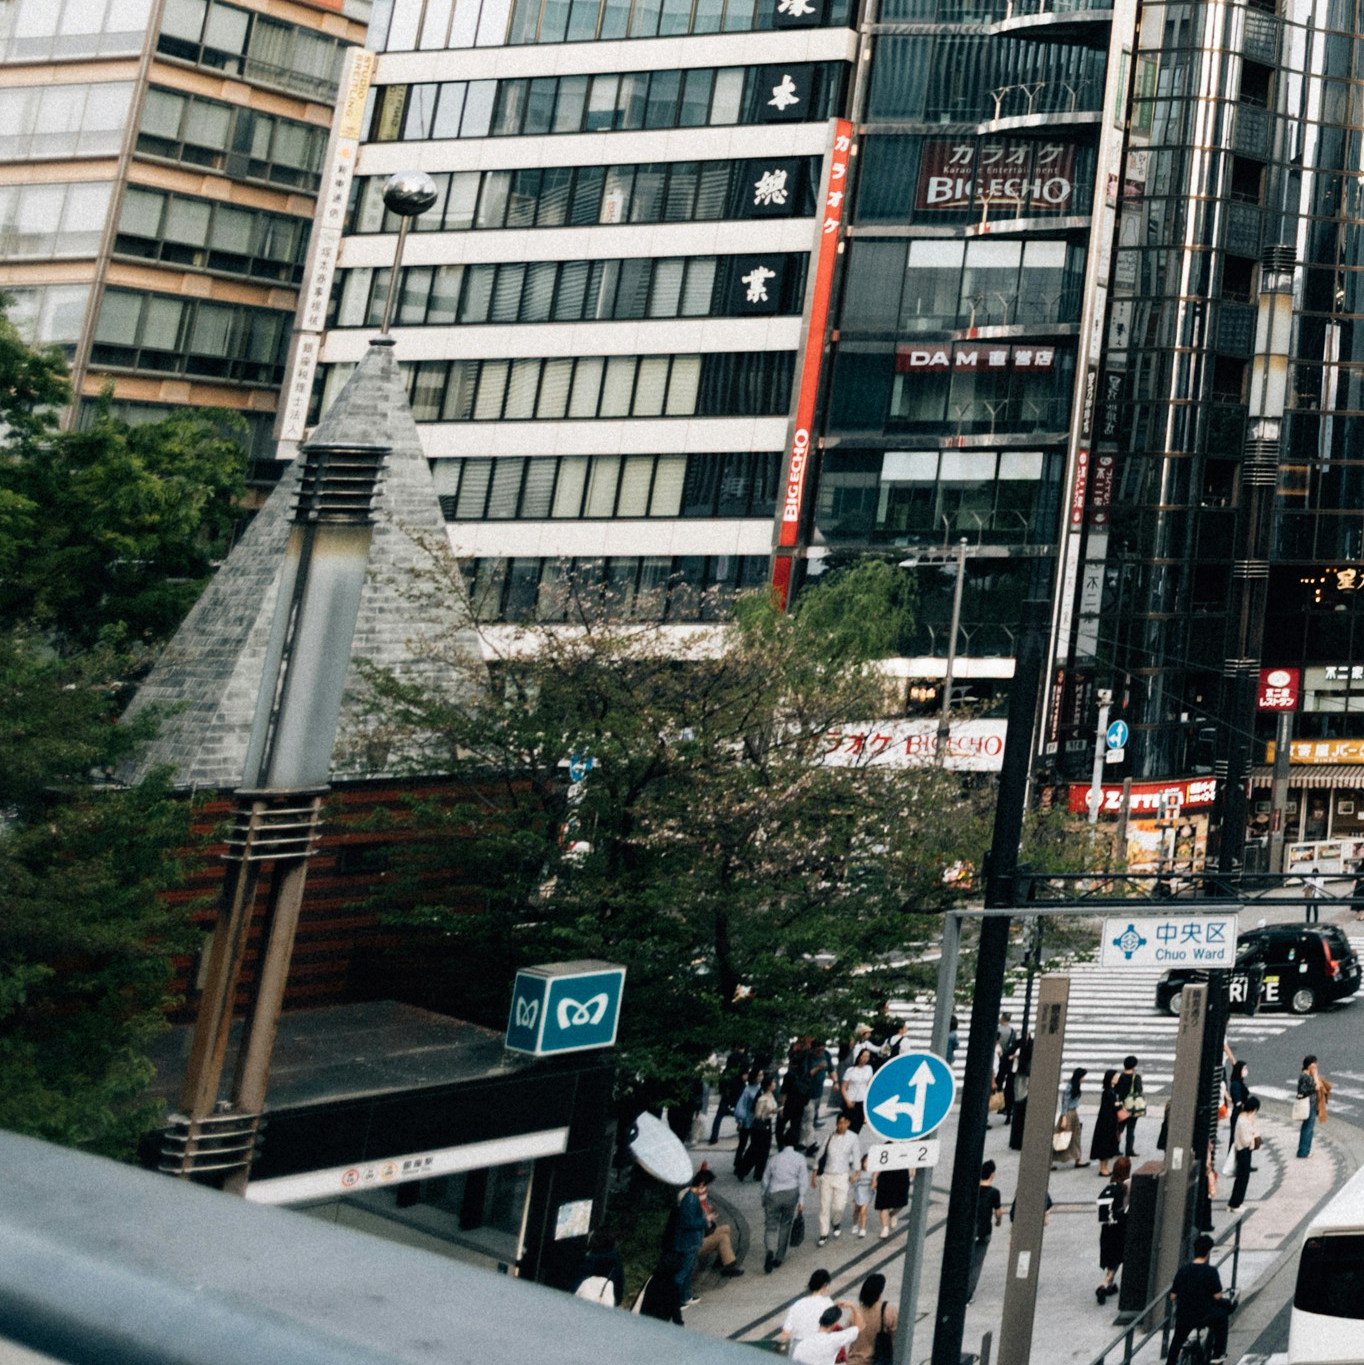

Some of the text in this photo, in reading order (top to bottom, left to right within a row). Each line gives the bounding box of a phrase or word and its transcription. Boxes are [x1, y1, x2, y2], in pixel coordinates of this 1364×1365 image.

[345, 54, 364, 118] BREITLING
[357, 55, 371, 100] STUDIO
[949, 143, 1064, 165] カラオケ
[823, 135, 851, 235] カラオケ
[926, 176, 1071, 204] BIG ECHO
[910, 351, 978, 366] DAM
[783, 428, 809, 523] BIG ECHO
[1259, 697, 1295, 707] レストラン
[1156, 922, 1227, 945] 中央区
[1155, 948, 1225, 961] Chuo Ward
